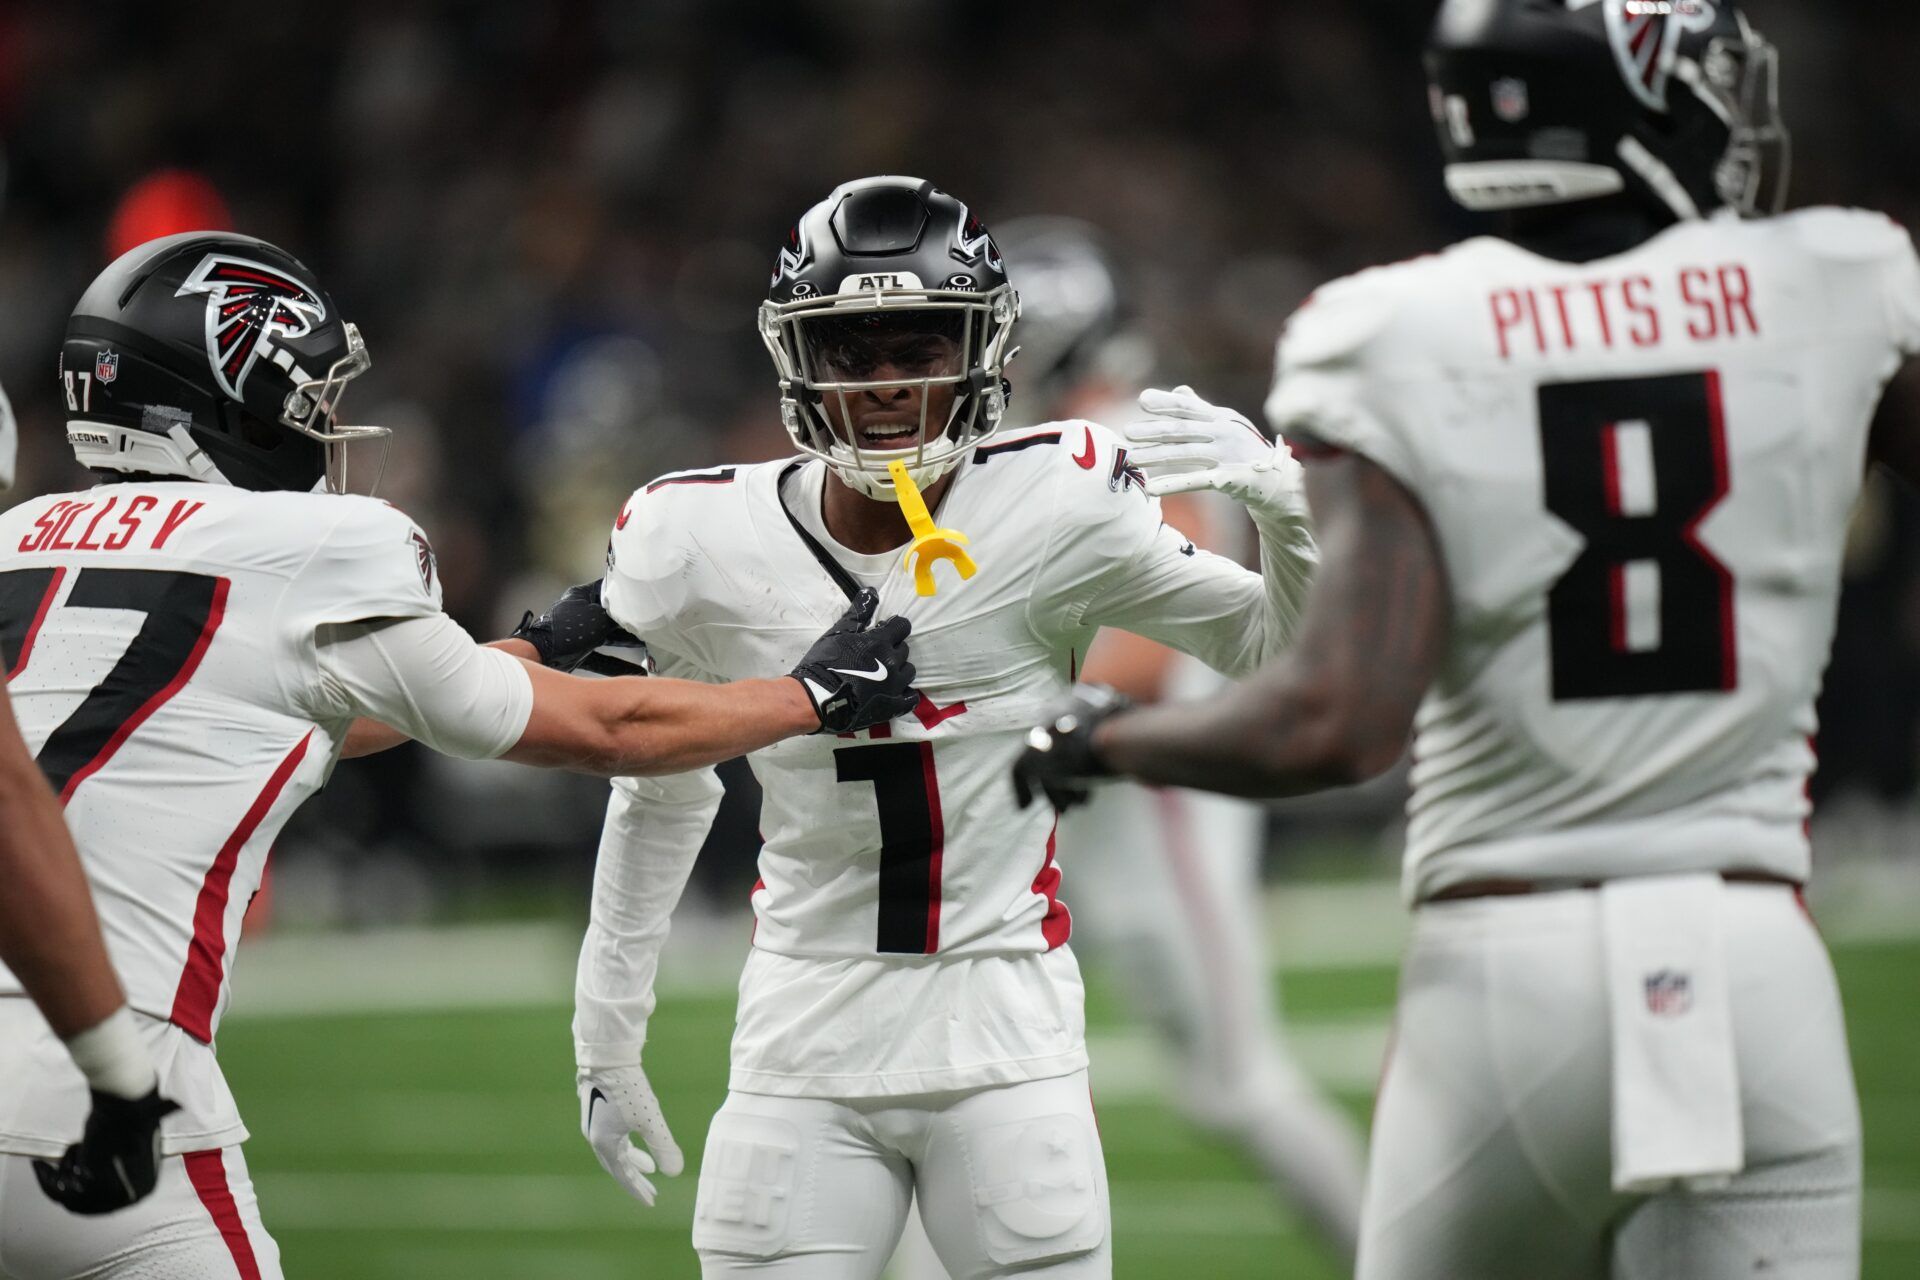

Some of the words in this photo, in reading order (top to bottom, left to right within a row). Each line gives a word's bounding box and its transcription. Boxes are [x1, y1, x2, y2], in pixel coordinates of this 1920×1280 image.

[859, 275, 903, 290] ATL
[1489, 275, 1661, 359] PITTS
[1677, 263, 1760, 341] SR
[64, 370, 91, 412] 87
[98, 363, 114, 379] NFL
[67, 432, 110, 445] ALCONS
[18, 496, 158, 553] SILLS
[1537, 368, 1738, 702] 8
[834, 740, 944, 953] 1
